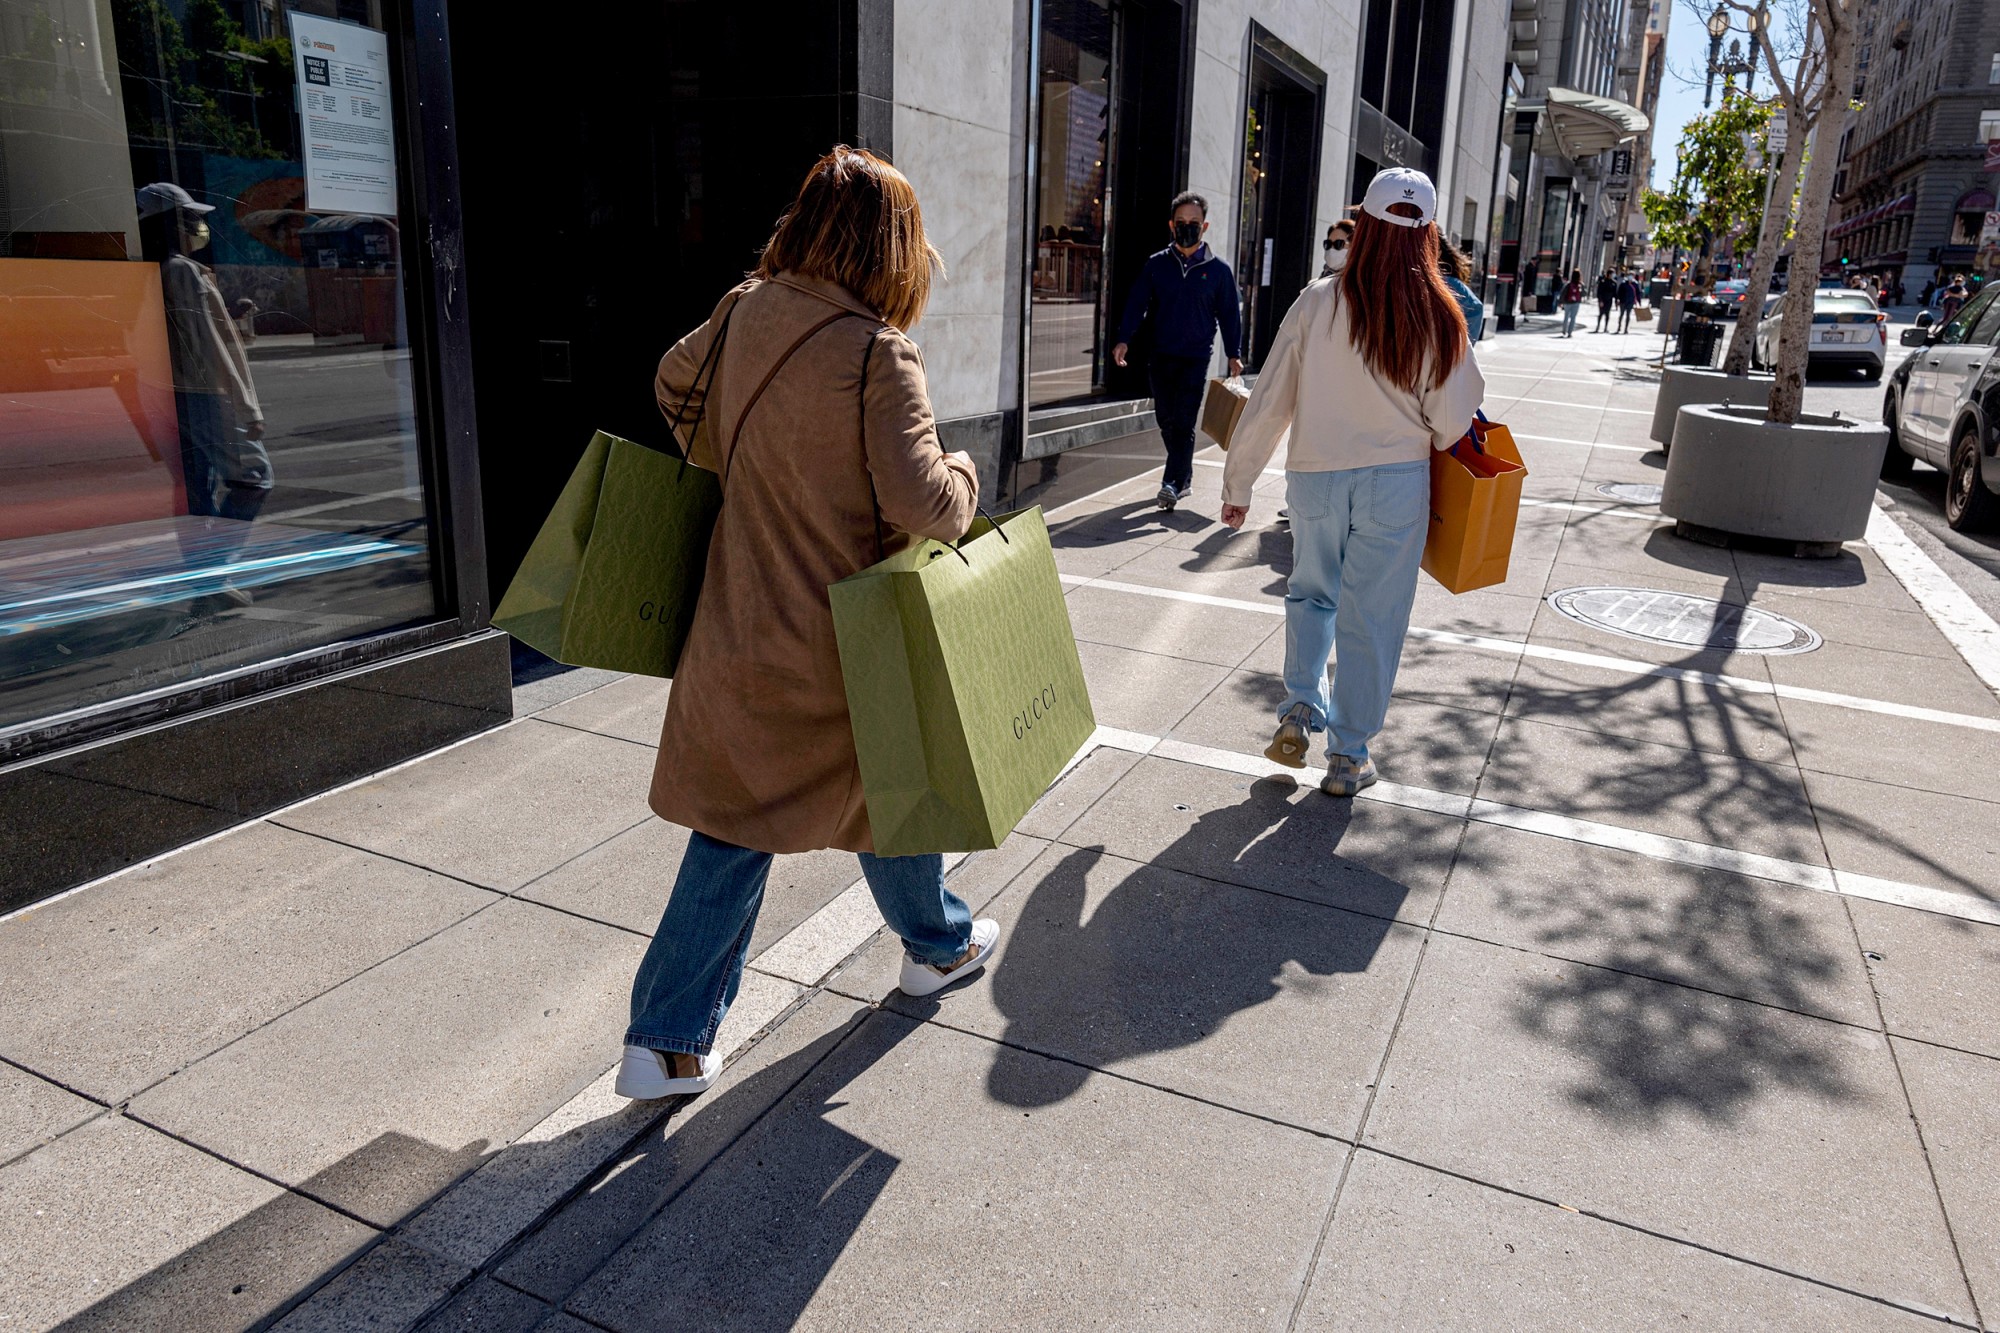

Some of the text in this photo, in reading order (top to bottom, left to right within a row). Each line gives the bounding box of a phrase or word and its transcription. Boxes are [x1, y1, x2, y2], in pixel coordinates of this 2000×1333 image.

[306, 58, 320, 67] NOTICE
[310, 67, 324, 75] PUBLIC
[309, 74, 326, 83] HEARING
[1013, 683, 1056, 740] GUCCI
